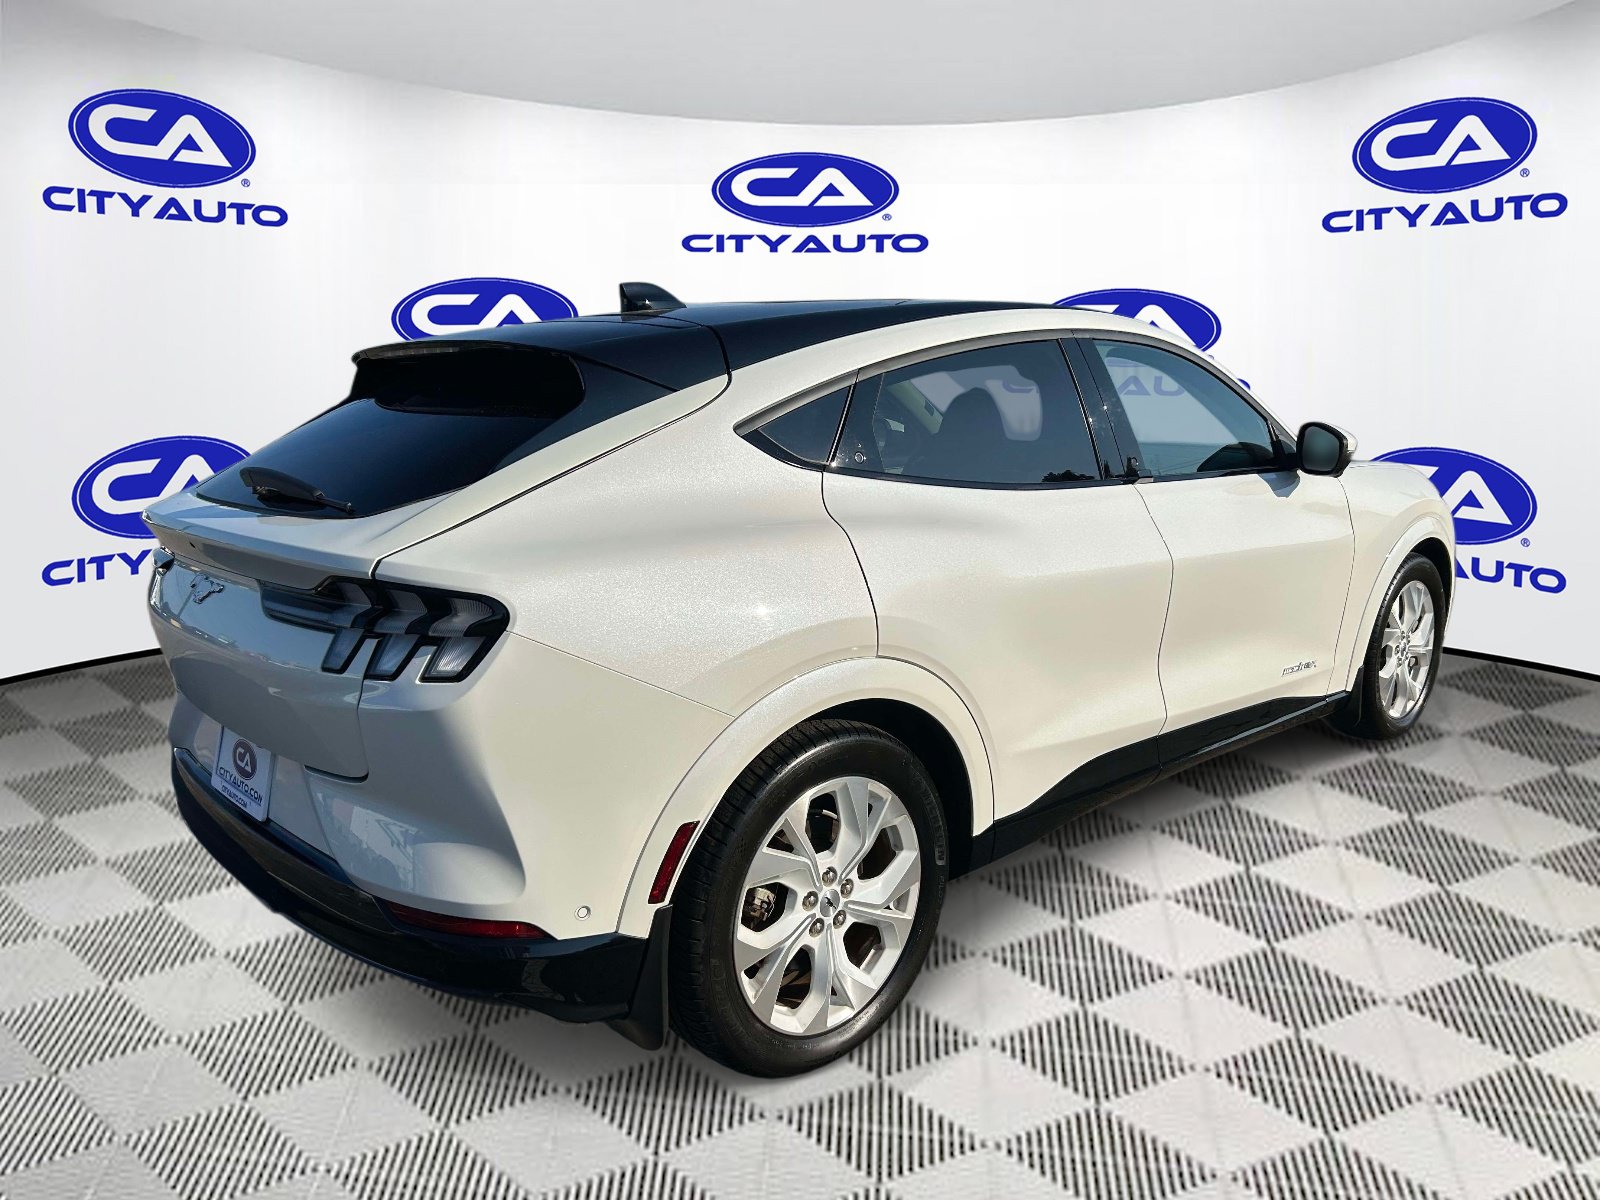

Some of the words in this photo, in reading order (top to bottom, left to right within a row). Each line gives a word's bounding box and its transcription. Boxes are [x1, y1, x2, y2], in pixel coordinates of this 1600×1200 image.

[89, 104, 232, 168] CA
[1371, 115, 1511, 171] CA
[731, 167, 874, 207] CA
[236, 746, 252, 773] CA
